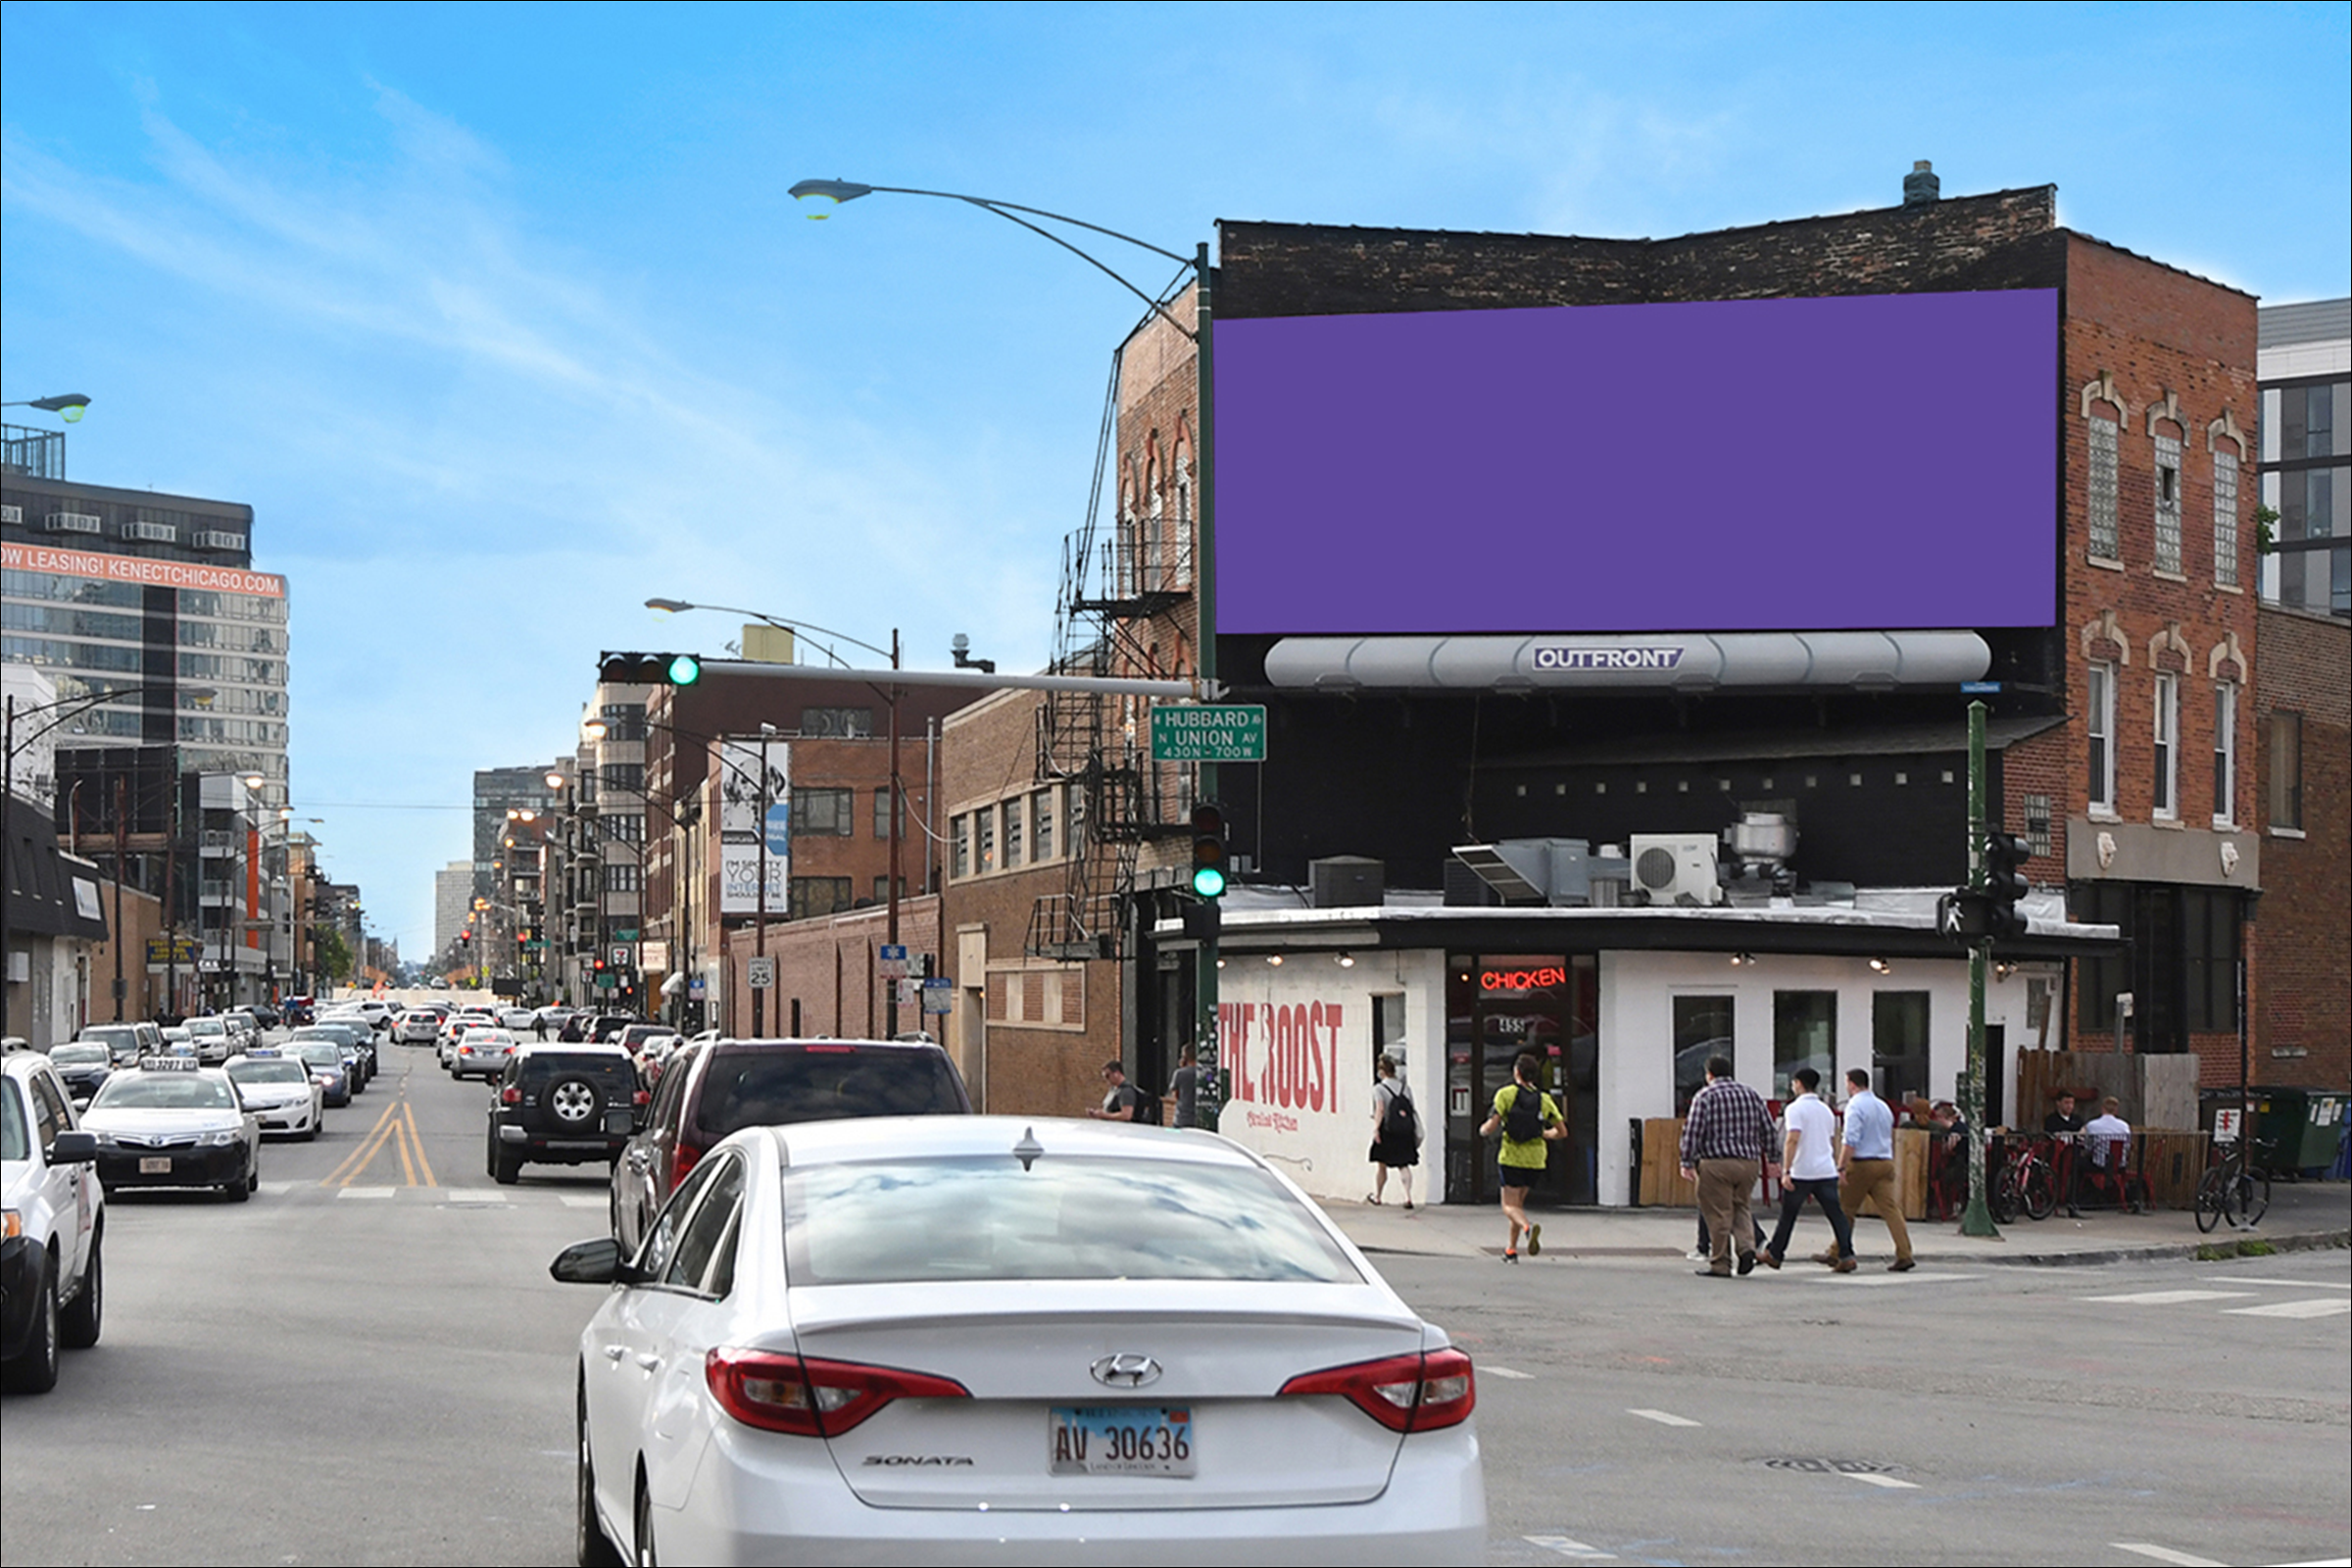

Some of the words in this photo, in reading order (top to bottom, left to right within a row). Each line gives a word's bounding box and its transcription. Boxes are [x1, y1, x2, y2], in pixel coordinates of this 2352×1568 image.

[27, 551, 104, 575] LEASING!
[109, 560, 279, 593] KENECTCHICAGO.COM
[1538, 649, 1677, 667] OUTFRONT
[1165, 711, 1249, 727] HUBBARD
[1158, 733, 1167, 743] N
[1176, 730, 1234, 746] UNION
[1242, 733, 1257, 743] AV
[1164, 747, 1200, 758] 430N
[1215, 747, 1252, 758] 700W
[726, 883, 781, 892] INTERET
[751, 972, 770, 985] 25
[1481, 967, 1566, 990] CHICKEN
[1260, 1000, 1343, 1114] ROOST
[1056, 1426, 1088, 1460] AV
[1105, 1426, 1189, 1460] 30636
[861, 1455, 974, 1466] SONATA
